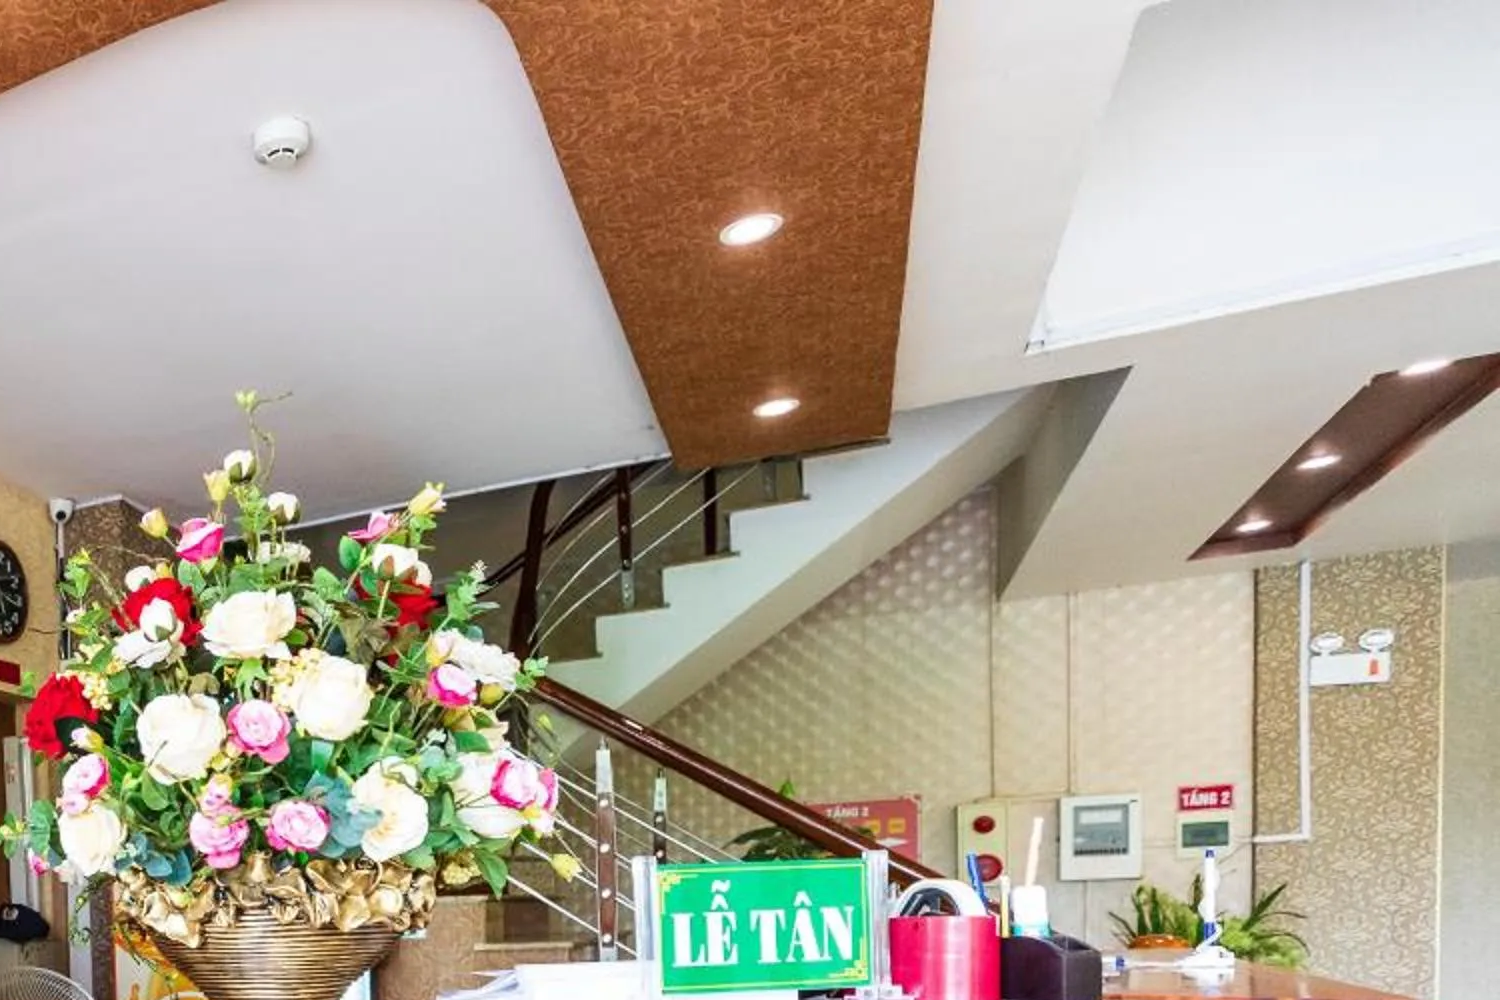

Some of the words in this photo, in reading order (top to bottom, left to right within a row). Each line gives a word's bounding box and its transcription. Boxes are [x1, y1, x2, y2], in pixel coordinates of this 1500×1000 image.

[1221, 791, 1231, 805] 2
[669, 879, 739, 968] LỄ
[750, 890, 855, 965] TÂN
